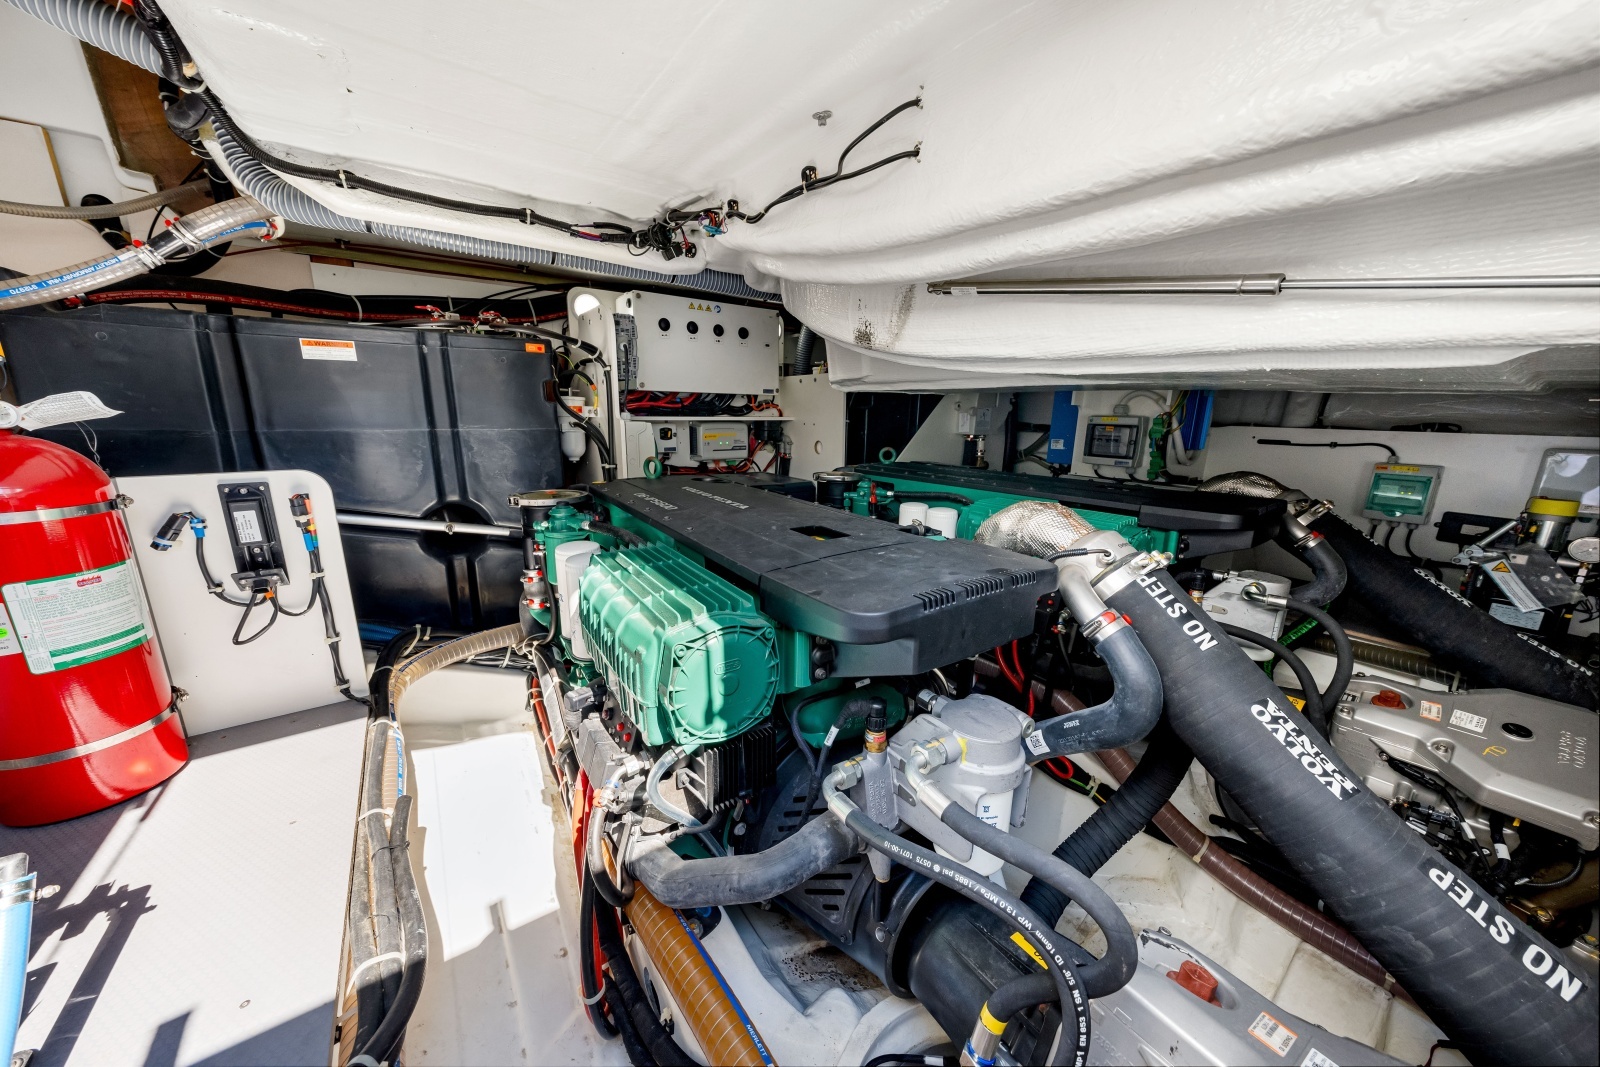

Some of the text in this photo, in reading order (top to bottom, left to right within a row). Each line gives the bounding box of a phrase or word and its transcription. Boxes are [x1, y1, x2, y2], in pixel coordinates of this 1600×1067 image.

[1136, 575, 1219, 652] NO STEP
[1250, 704, 1342, 801] VOLVO
[1267, 697, 1358, 794] PENTA
[915, 856, 932, 868] 0575
[942, 868, 954, 877] psi
[954, 874, 972, 888] 1885
[980, 888, 999, 904] MPa
[1017, 916, 1032, 931] WP
[1035, 929, 1056, 955] 16mm
[1428, 867, 1583, 1002] NO STEP
[1054, 954, 1065, 966] ID
[1072, 989, 1083, 1005] SN
[1079, 1016, 1087, 1033] 853
[746, 1024, 769, 1057] MERLETT
[1079, 1034, 1087, 1047] EN
